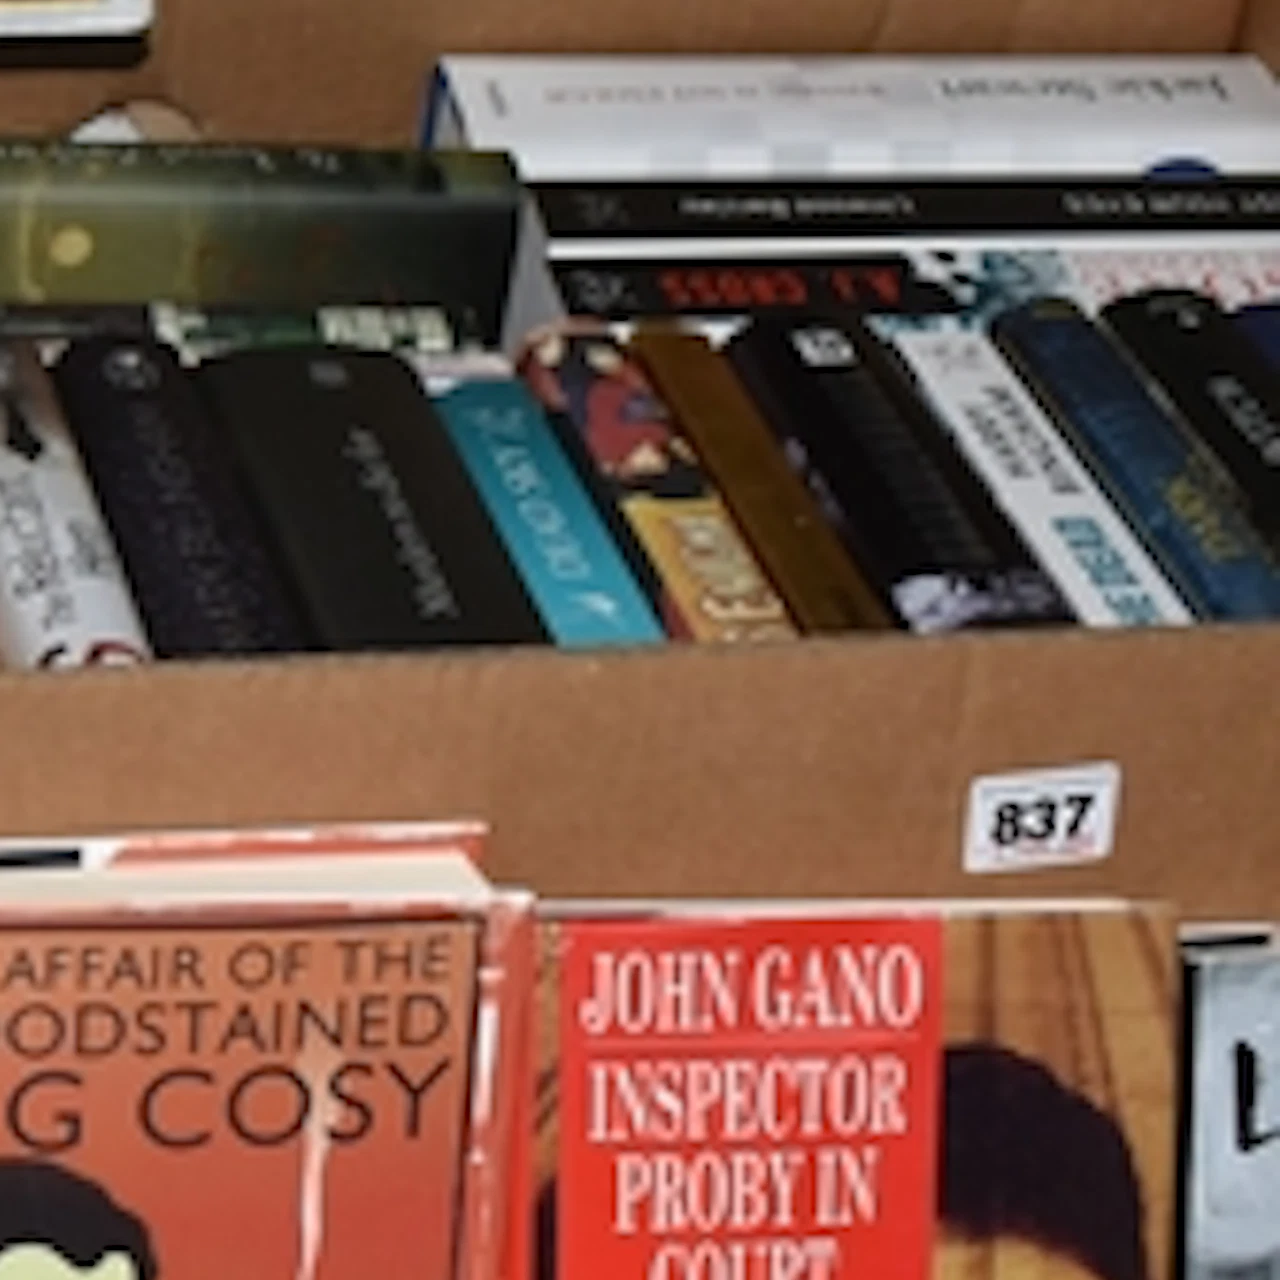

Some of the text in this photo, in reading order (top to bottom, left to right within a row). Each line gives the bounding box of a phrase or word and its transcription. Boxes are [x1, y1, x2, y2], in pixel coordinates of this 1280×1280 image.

[989, 793, 1096, 851] 837
[228, 939, 313, 987] OF
[338, 931, 452, 984] THE
[578, 943, 924, 1035] JOHN GANO
[137, 1057, 451, 1149] COSY
[586, 1055, 908, 1144] INSPECTOR
[614, 1144, 880, 1235] PROBY IN
